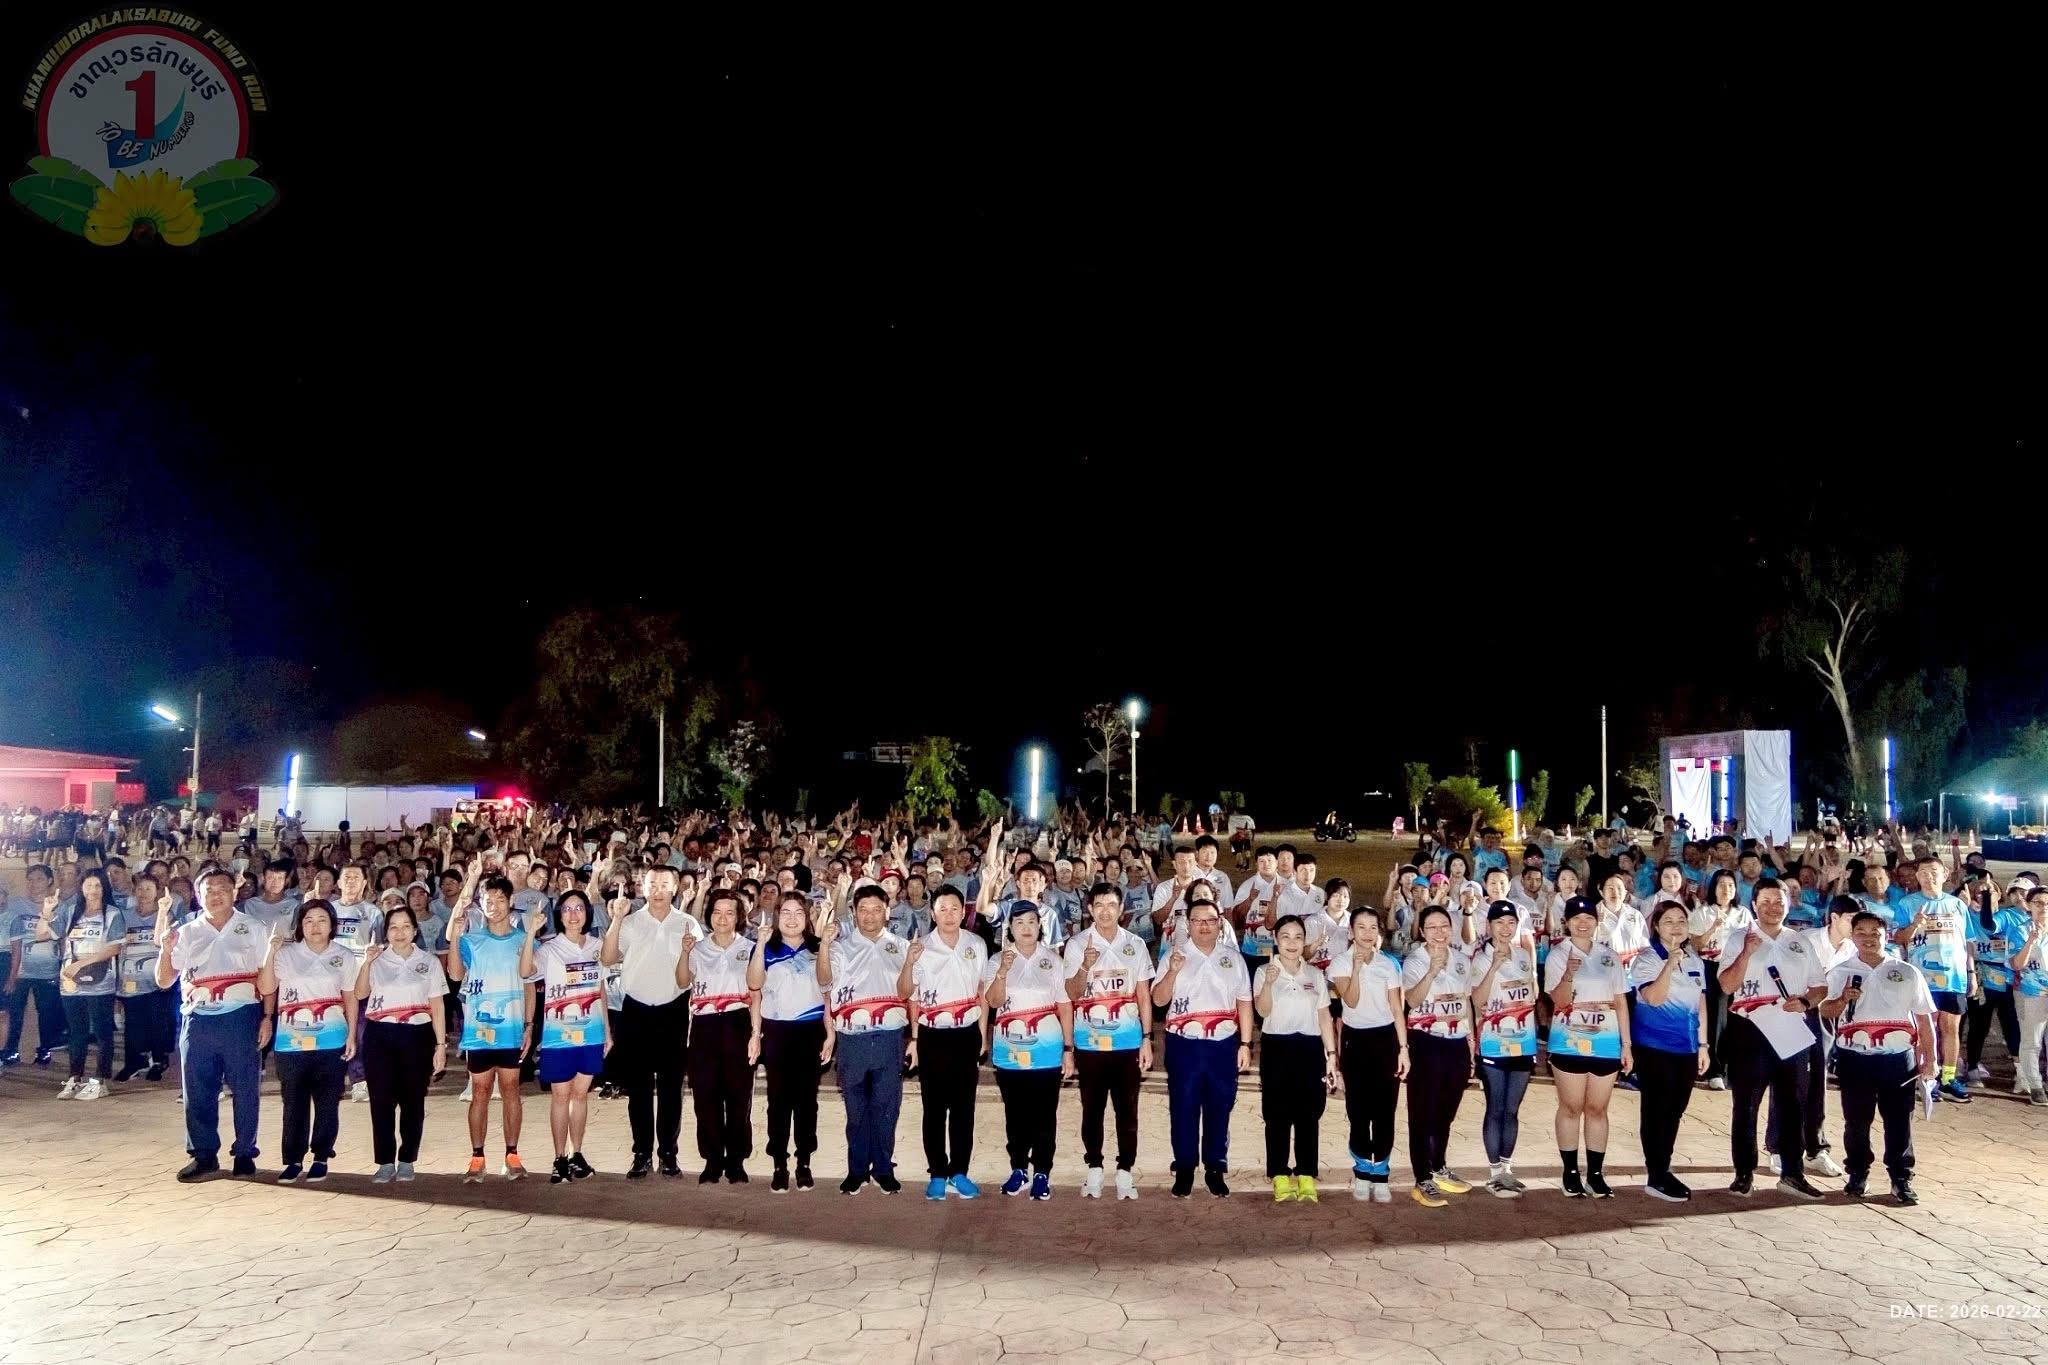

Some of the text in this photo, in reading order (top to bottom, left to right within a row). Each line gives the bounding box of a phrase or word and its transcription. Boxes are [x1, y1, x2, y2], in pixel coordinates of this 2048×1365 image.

[342, 926, 356, 934] 139
[582, 972, 598, 981] 388
[1100, 979, 1124, 990] VIP
[1508, 987, 1529, 1000] VIP
[1441, 1003, 1462, 1014] VIP
[1581, 1013, 1605, 1025] VIP
